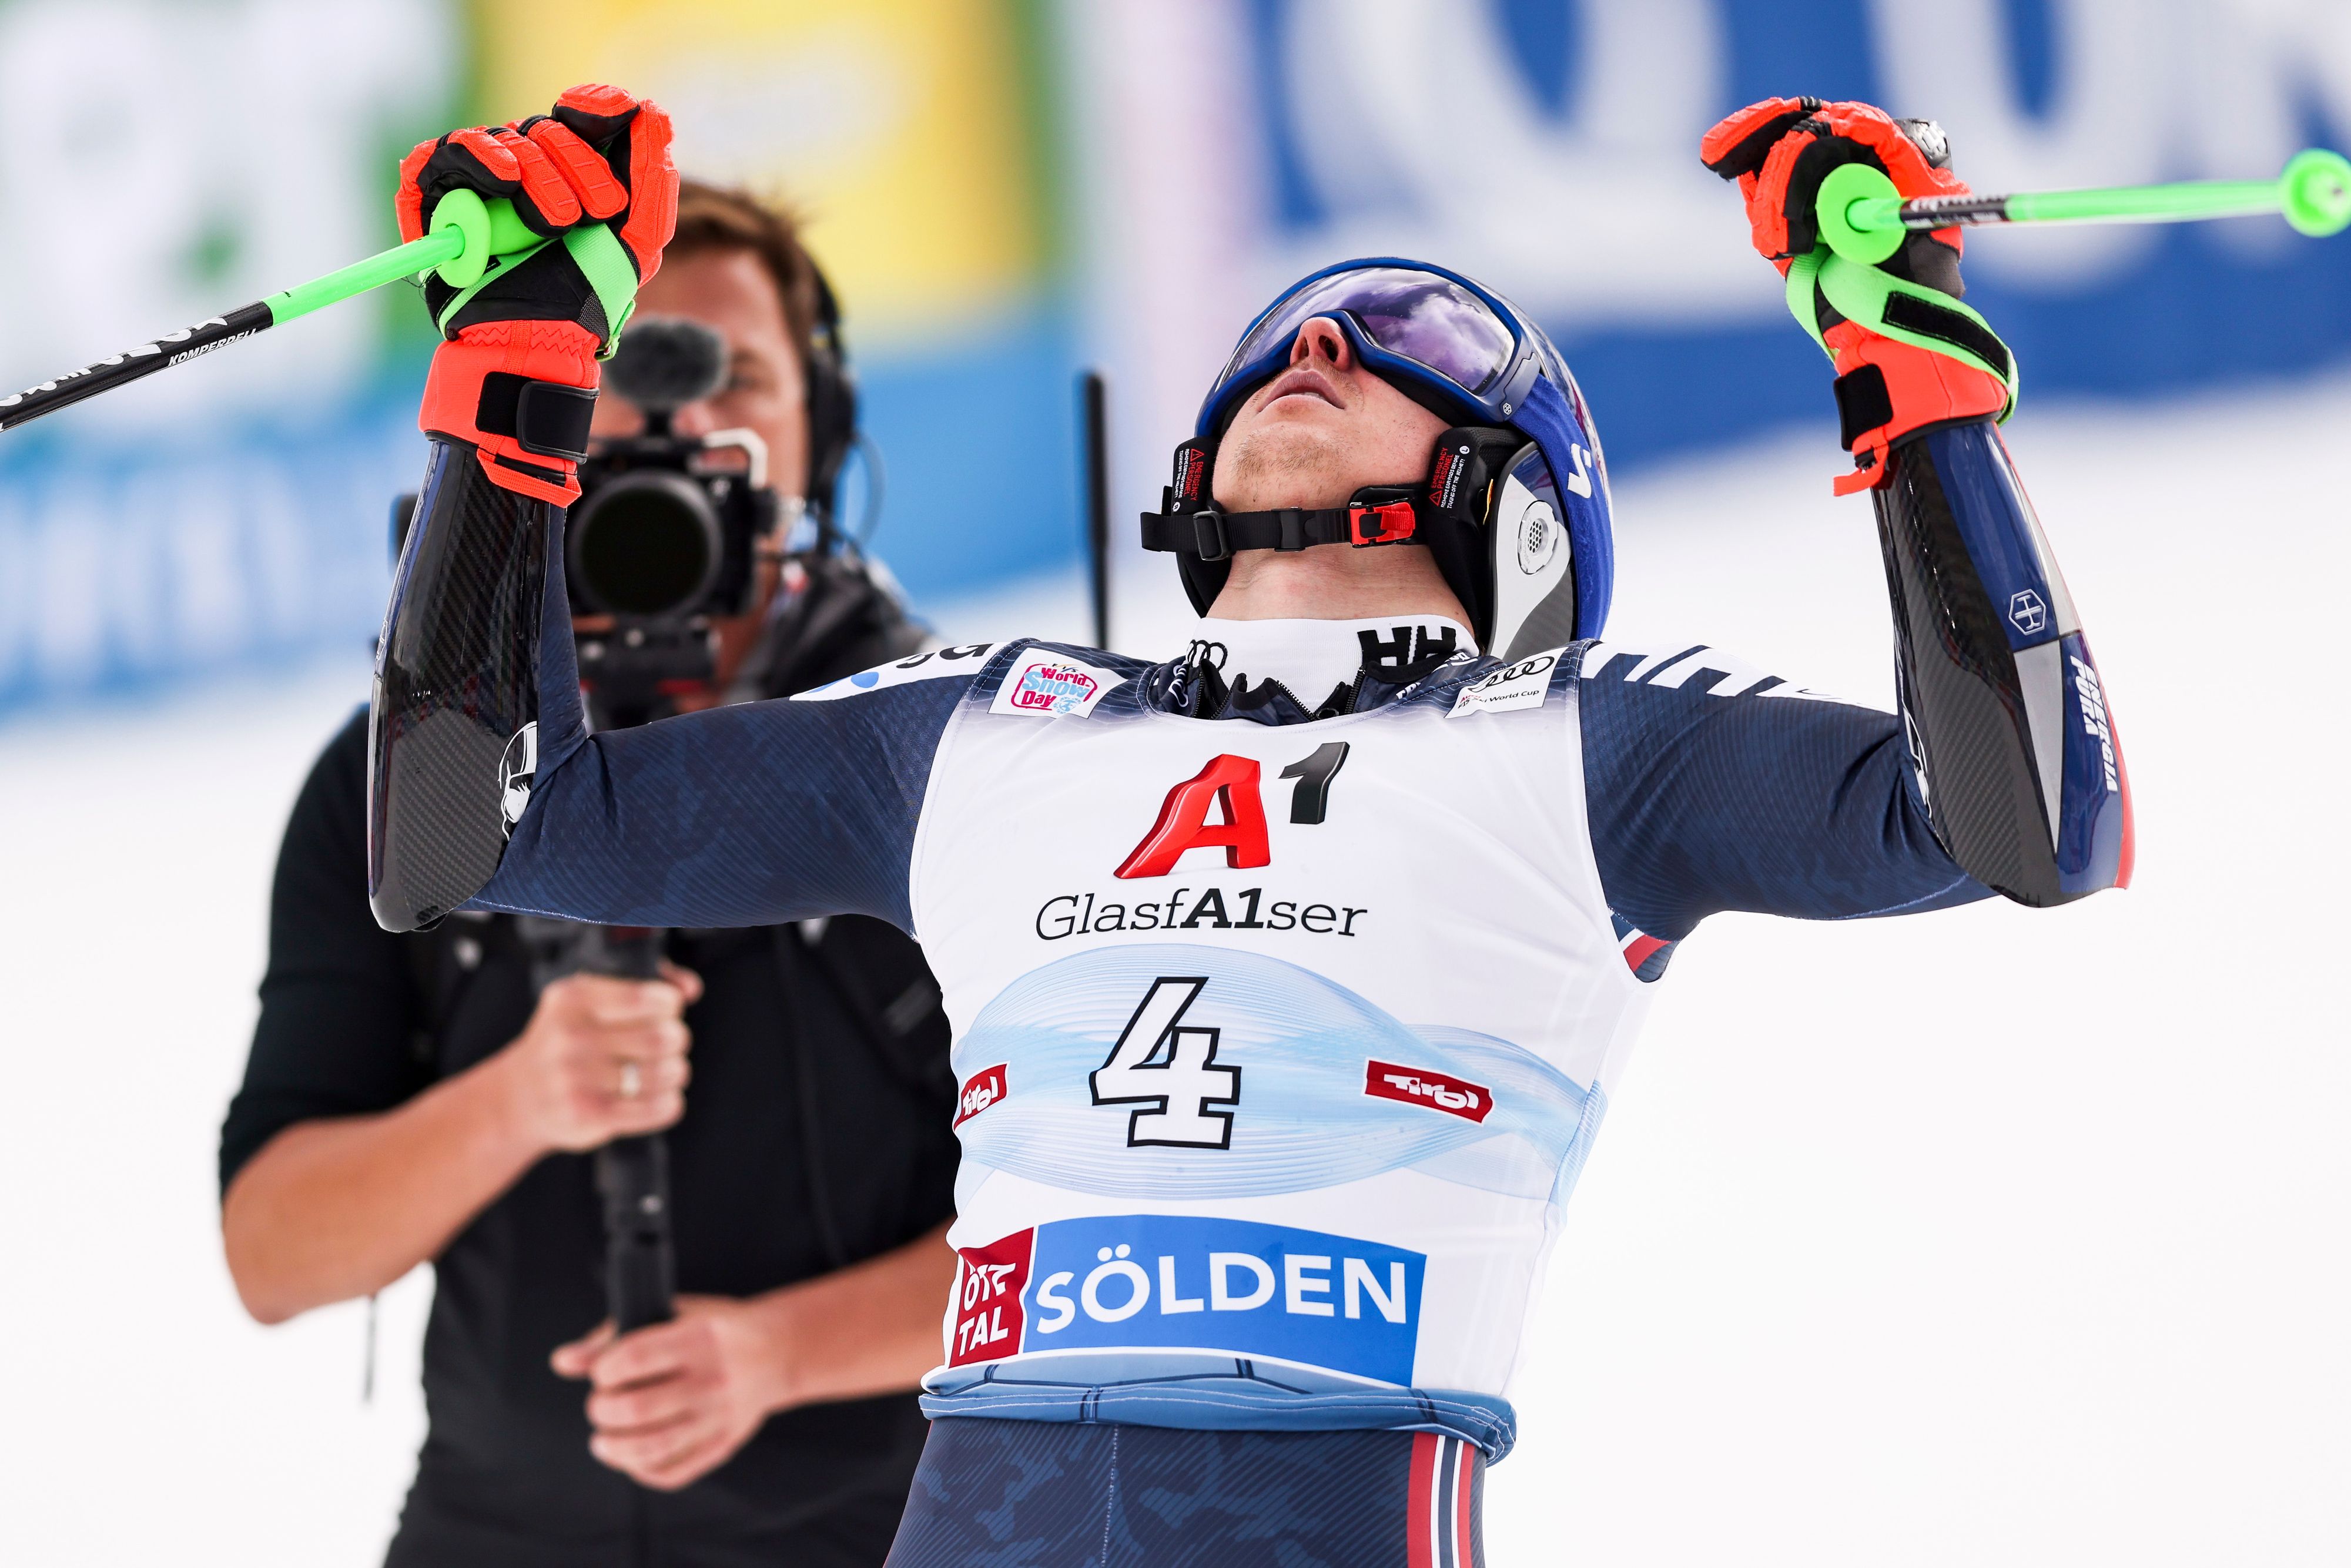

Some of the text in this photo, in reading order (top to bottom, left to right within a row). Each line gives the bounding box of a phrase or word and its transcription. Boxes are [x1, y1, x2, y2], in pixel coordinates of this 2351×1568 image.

[168, 328, 256, 367] KOMPERDELL
[1191, 461, 1204, 501] EMERGENCY
[1431, 447, 1448, 488] EMERGENCY
[1437, 454, 1454, 489] PERSONEL
[1441, 489, 1449, 508] REMOVE
[1451, 454, 1460, 470] BEFORE
[1447, 492, 1455, 508] TAKING
[1022, 672, 1090, 698] Snow
[1041, 668, 1085, 685] World
[2070, 655, 2099, 736] PURA
[1021, 691, 1057, 707] Day
[1489, 692, 1519, 702] World
[2084, 664, 2118, 792] ENERGIA
[1113, 742, 1350, 879] A1
[1036, 888, 1367, 940] GlasfA1ser
[1089, 976, 1241, 1150] 4
[963, 1076, 998, 1116] Tirol
[1384, 1074, 1479, 1110] Tirol
[1036, 1243, 1407, 1334] SÖLDEN
[959, 1306, 1009, 1357] TAL
